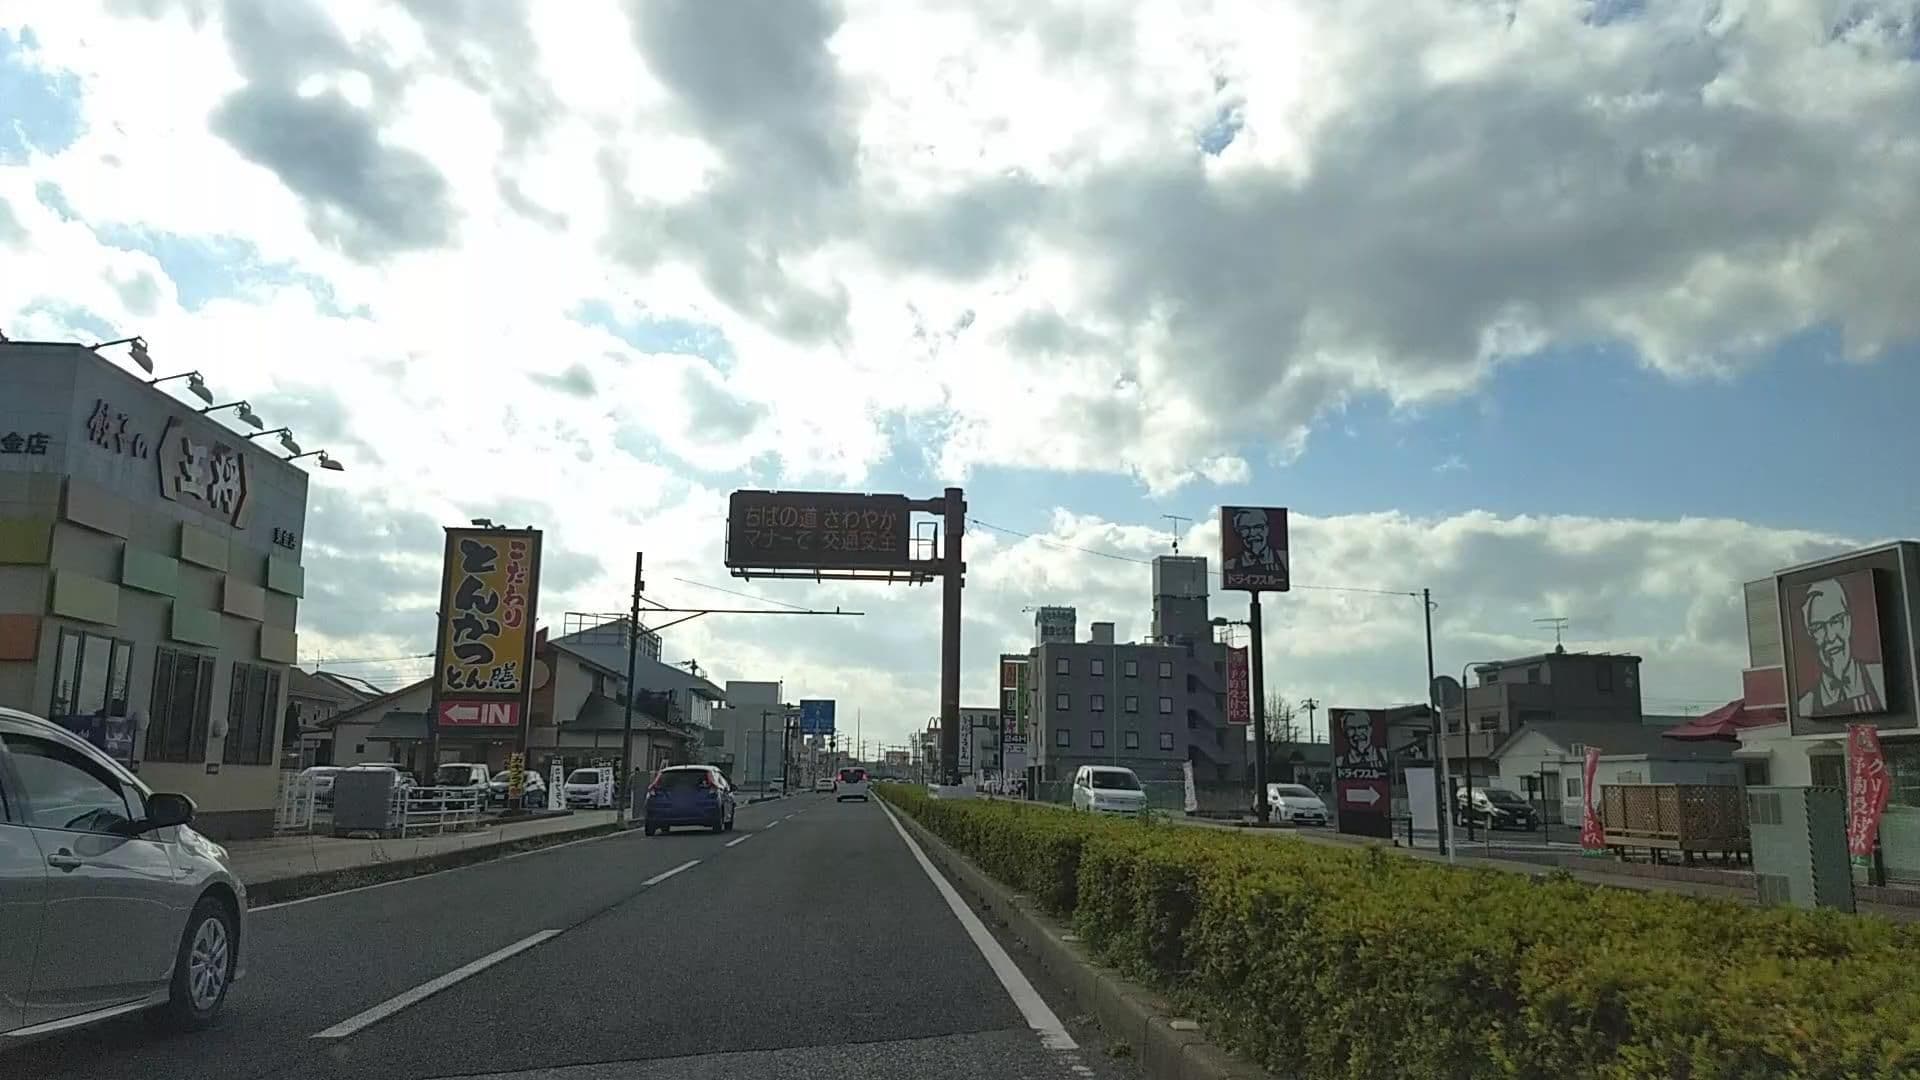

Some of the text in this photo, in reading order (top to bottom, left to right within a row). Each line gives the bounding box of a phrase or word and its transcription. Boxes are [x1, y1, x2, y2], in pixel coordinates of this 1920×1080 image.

[743, 506, 897, 531] ちばの道 さわやか
[743, 529, 897, 552] マナーで 交通安全
[503, 541, 529, 628] こだわり
[452, 538, 501, 666] とんかつ
[446, 661, 519, 690] とん膳
[480, 703, 511, 724] IN
